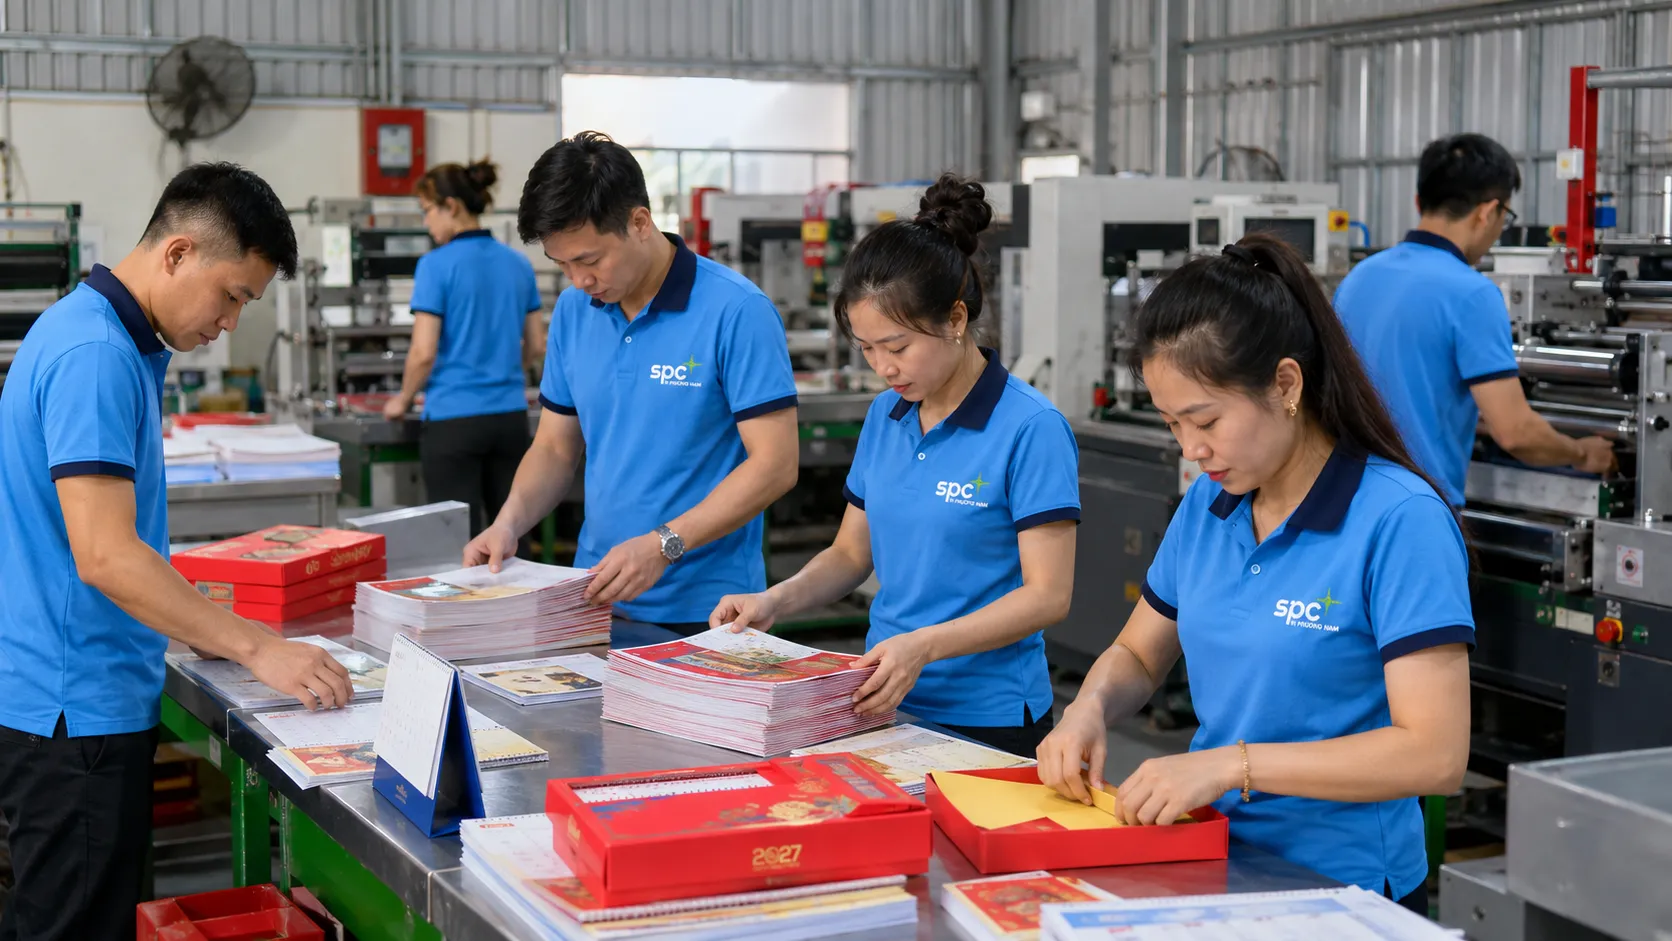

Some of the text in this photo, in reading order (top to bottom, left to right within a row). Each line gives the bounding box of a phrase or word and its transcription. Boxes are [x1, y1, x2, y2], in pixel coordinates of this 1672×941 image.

[650, 364, 687, 385] spc
[935, 480, 974, 503] spc
[1273, 599, 1322, 625] spc
[752, 844, 802, 866] 2027
